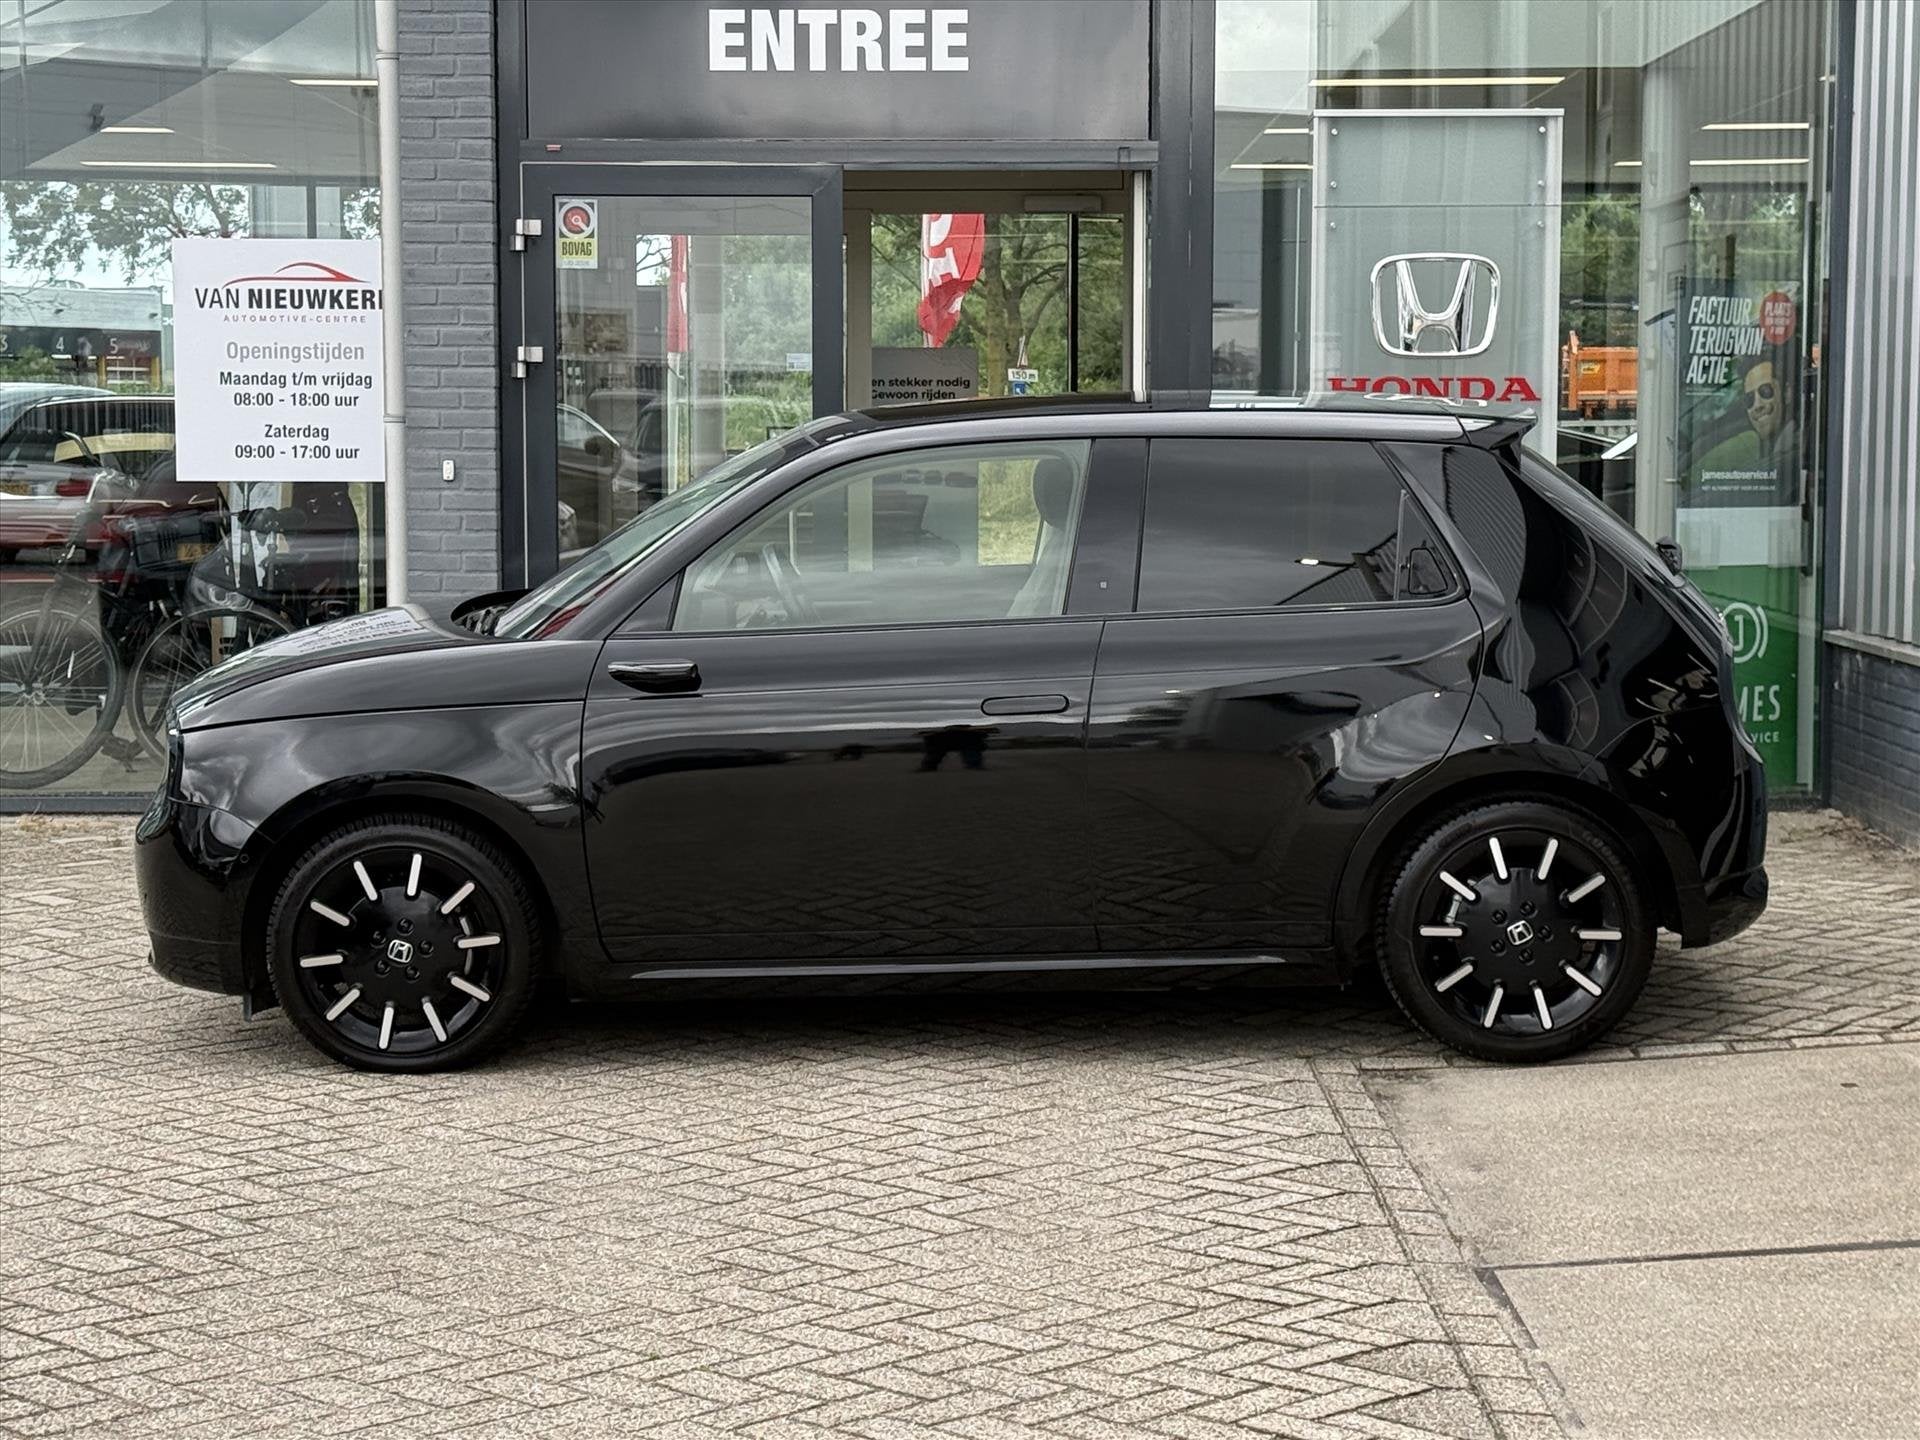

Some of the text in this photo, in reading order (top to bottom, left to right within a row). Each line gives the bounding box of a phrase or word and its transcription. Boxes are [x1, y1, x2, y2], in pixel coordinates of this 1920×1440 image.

[708, 9, 969, 71] ENTREE
[561, 241, 592, 256] BOVAG
[195, 288, 239, 309] VAN
[1688, 296, 1752, 325] FACTUUR
[224, 315, 366, 324] AUTOMOTIVE-CENTRE
[56, 336, 65, 352] 4
[110, 337, 119, 354] 5
[1689, 326, 1765, 355] TERUGWIN
[226, 341, 365, 363] Openingstijden
[1012, 371, 1027, 380] 150
[1686, 355, 1732, 384] ACTIE
[219, 371, 373, 389] Maandag t/m vrijdag
[872, 377, 970, 389] en stekker nodig
[921, 389, 956, 401] rijden
[1327, 376, 1542, 402] HONDA
[233, 392, 274, 406] 08:00
[290, 393, 330, 407] 18:00
[335, 394, 360, 407] uur
[264, 424, 330, 440] Zaterdag
[234, 445, 275, 459] 09:00
[291, 445, 331, 459] 17:00
[335, 447, 360, 459] uur
[1750, 731, 1780, 743] VICE
